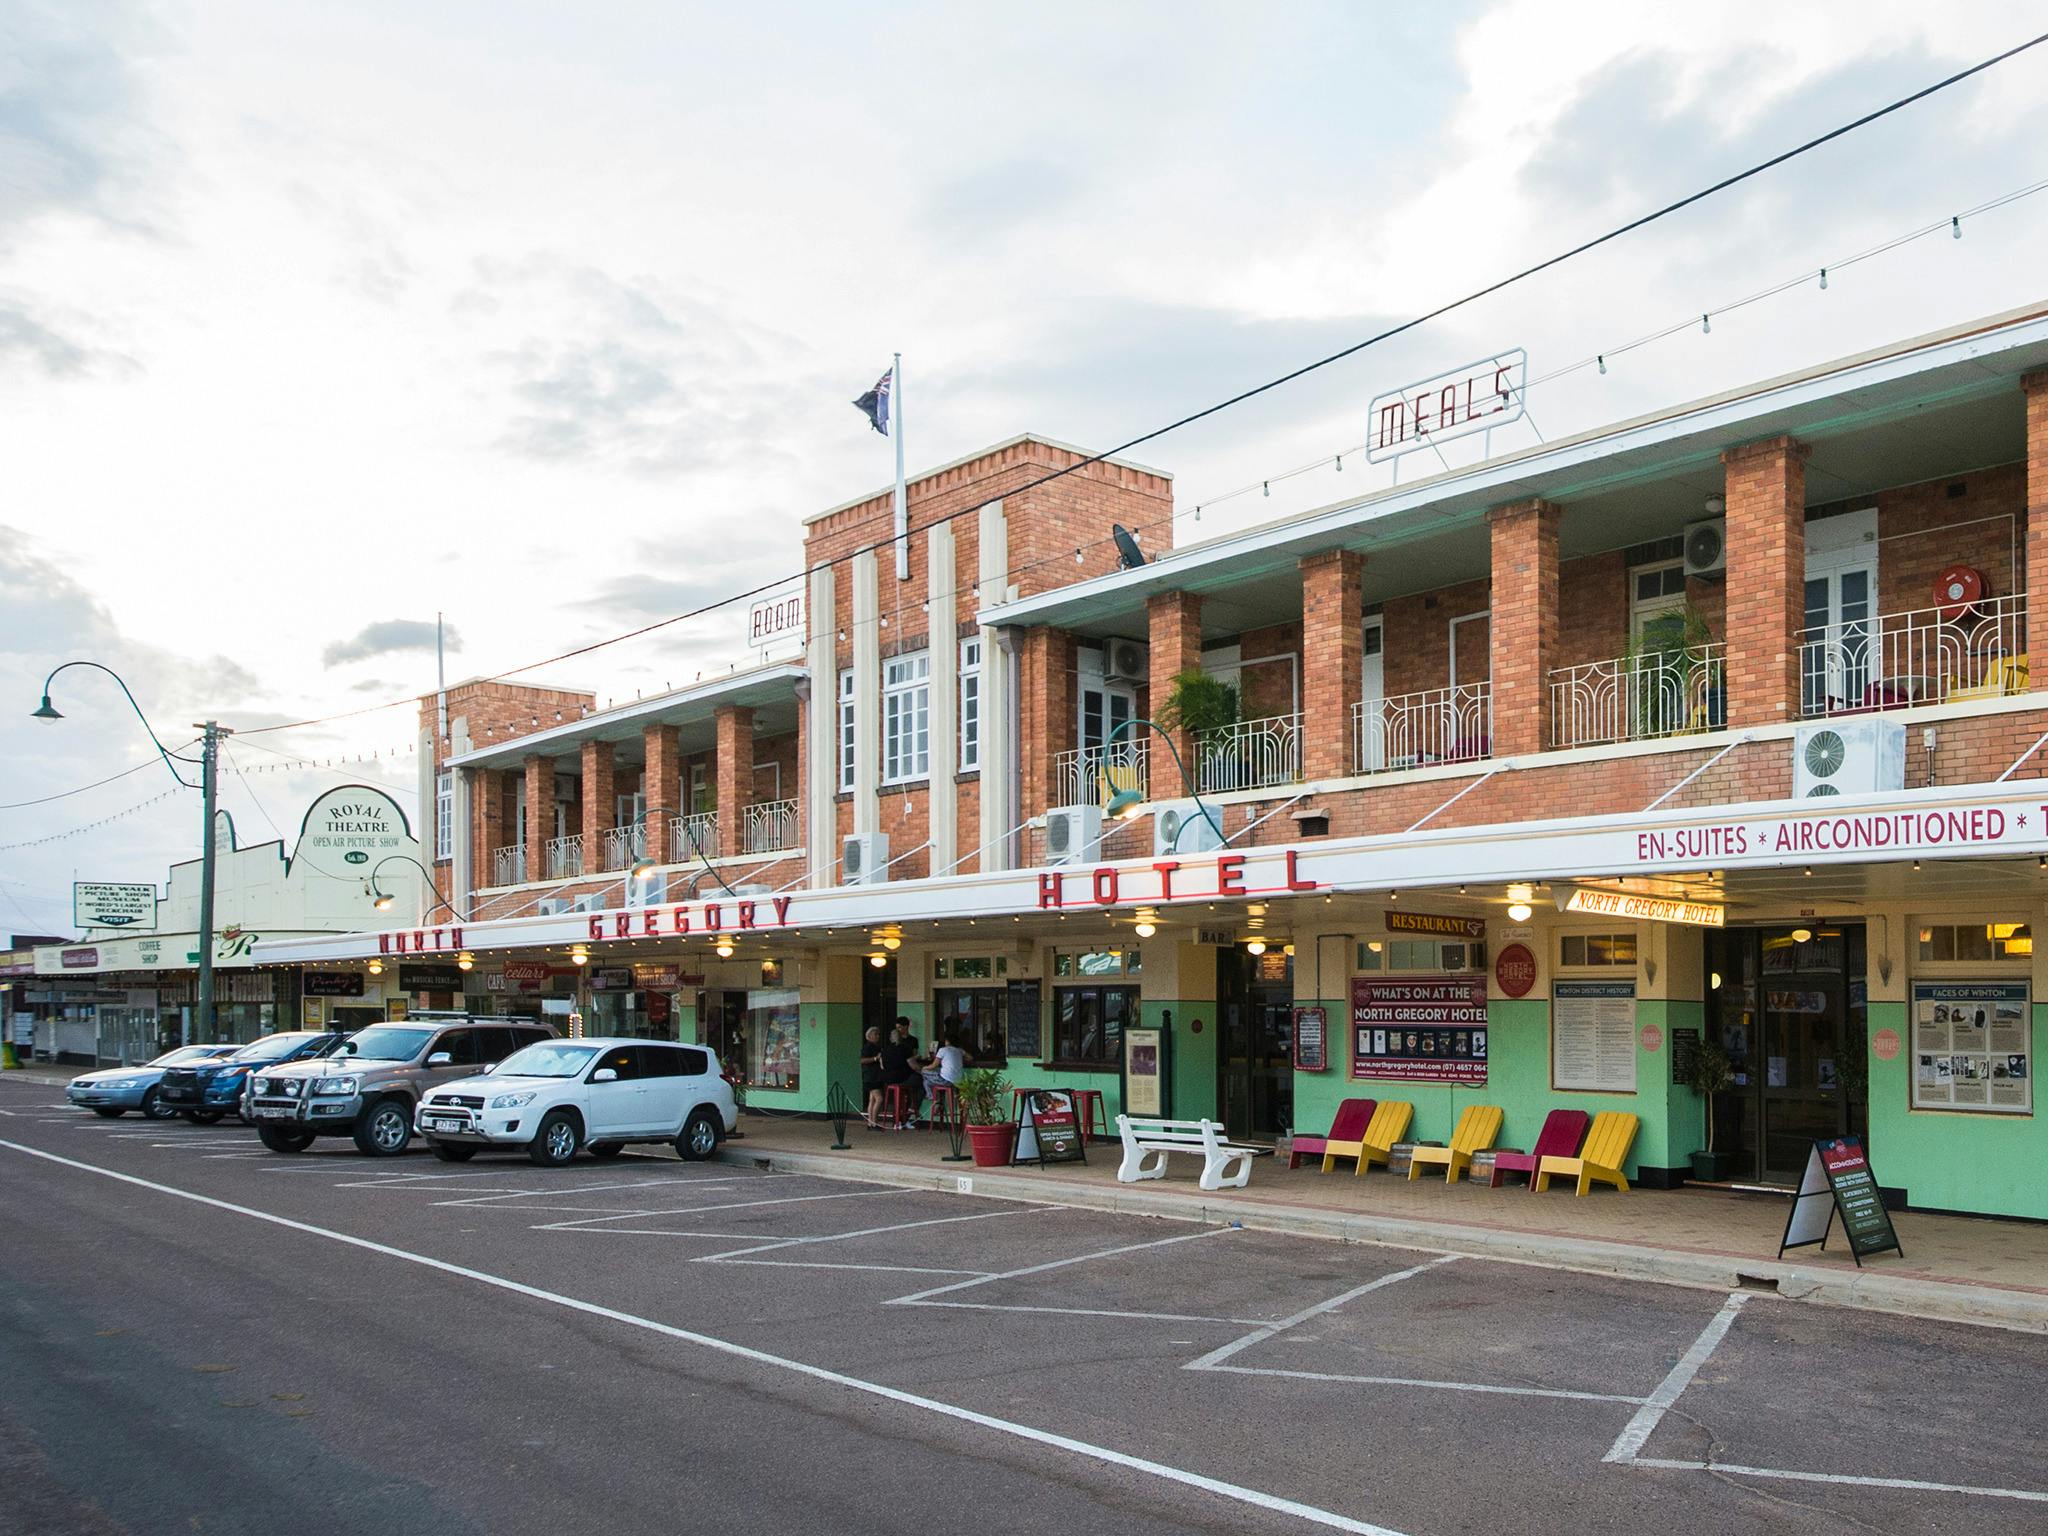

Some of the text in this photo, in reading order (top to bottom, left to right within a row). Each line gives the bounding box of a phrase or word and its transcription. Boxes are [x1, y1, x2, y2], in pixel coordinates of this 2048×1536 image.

[1379, 364, 1512, 449] MEALS
[329, 804, 382, 820] ROYAL
[325, 821, 390, 833] THEATRE
[1637, 825, 1748, 861] EN-SUITES
[1774, 808, 2006, 852] AIRCONDITIONED
[312, 836, 400, 848] OPEN AIR PICTURE SHOW
[378, 850, 1317, 954] NORTH GREGORY HOTEL
[1576, 891, 1718, 924] NORTH GREGORY HOTEL
[1392, 914, 1465, 933] RESTAURANT
[1201, 931, 1225, 944] BAR
[138, 941, 161, 951] COFFEE
[141, 954, 159, 964] SHOP
[505, 967, 544, 979] cellars
[660, 973, 677, 985] SHOP
[1371, 987, 1411, 999] WHAT'S
[1413, 987, 1429, 999] ON
[1432, 987, 1446, 999] AT
[1447, 987, 1470, 999] THE
[1932, 988, 2007, 997] FACES OF WINTON
[1355, 1008, 1488, 1021] NORTH GREGORY HOTEL
[1355, 1061, 1441, 1071] www.northgregoryhotel.com
[1442, 1063, 1456, 1072] (07)
[1829, 1157, 1865, 1170] ACCOMMODATION
